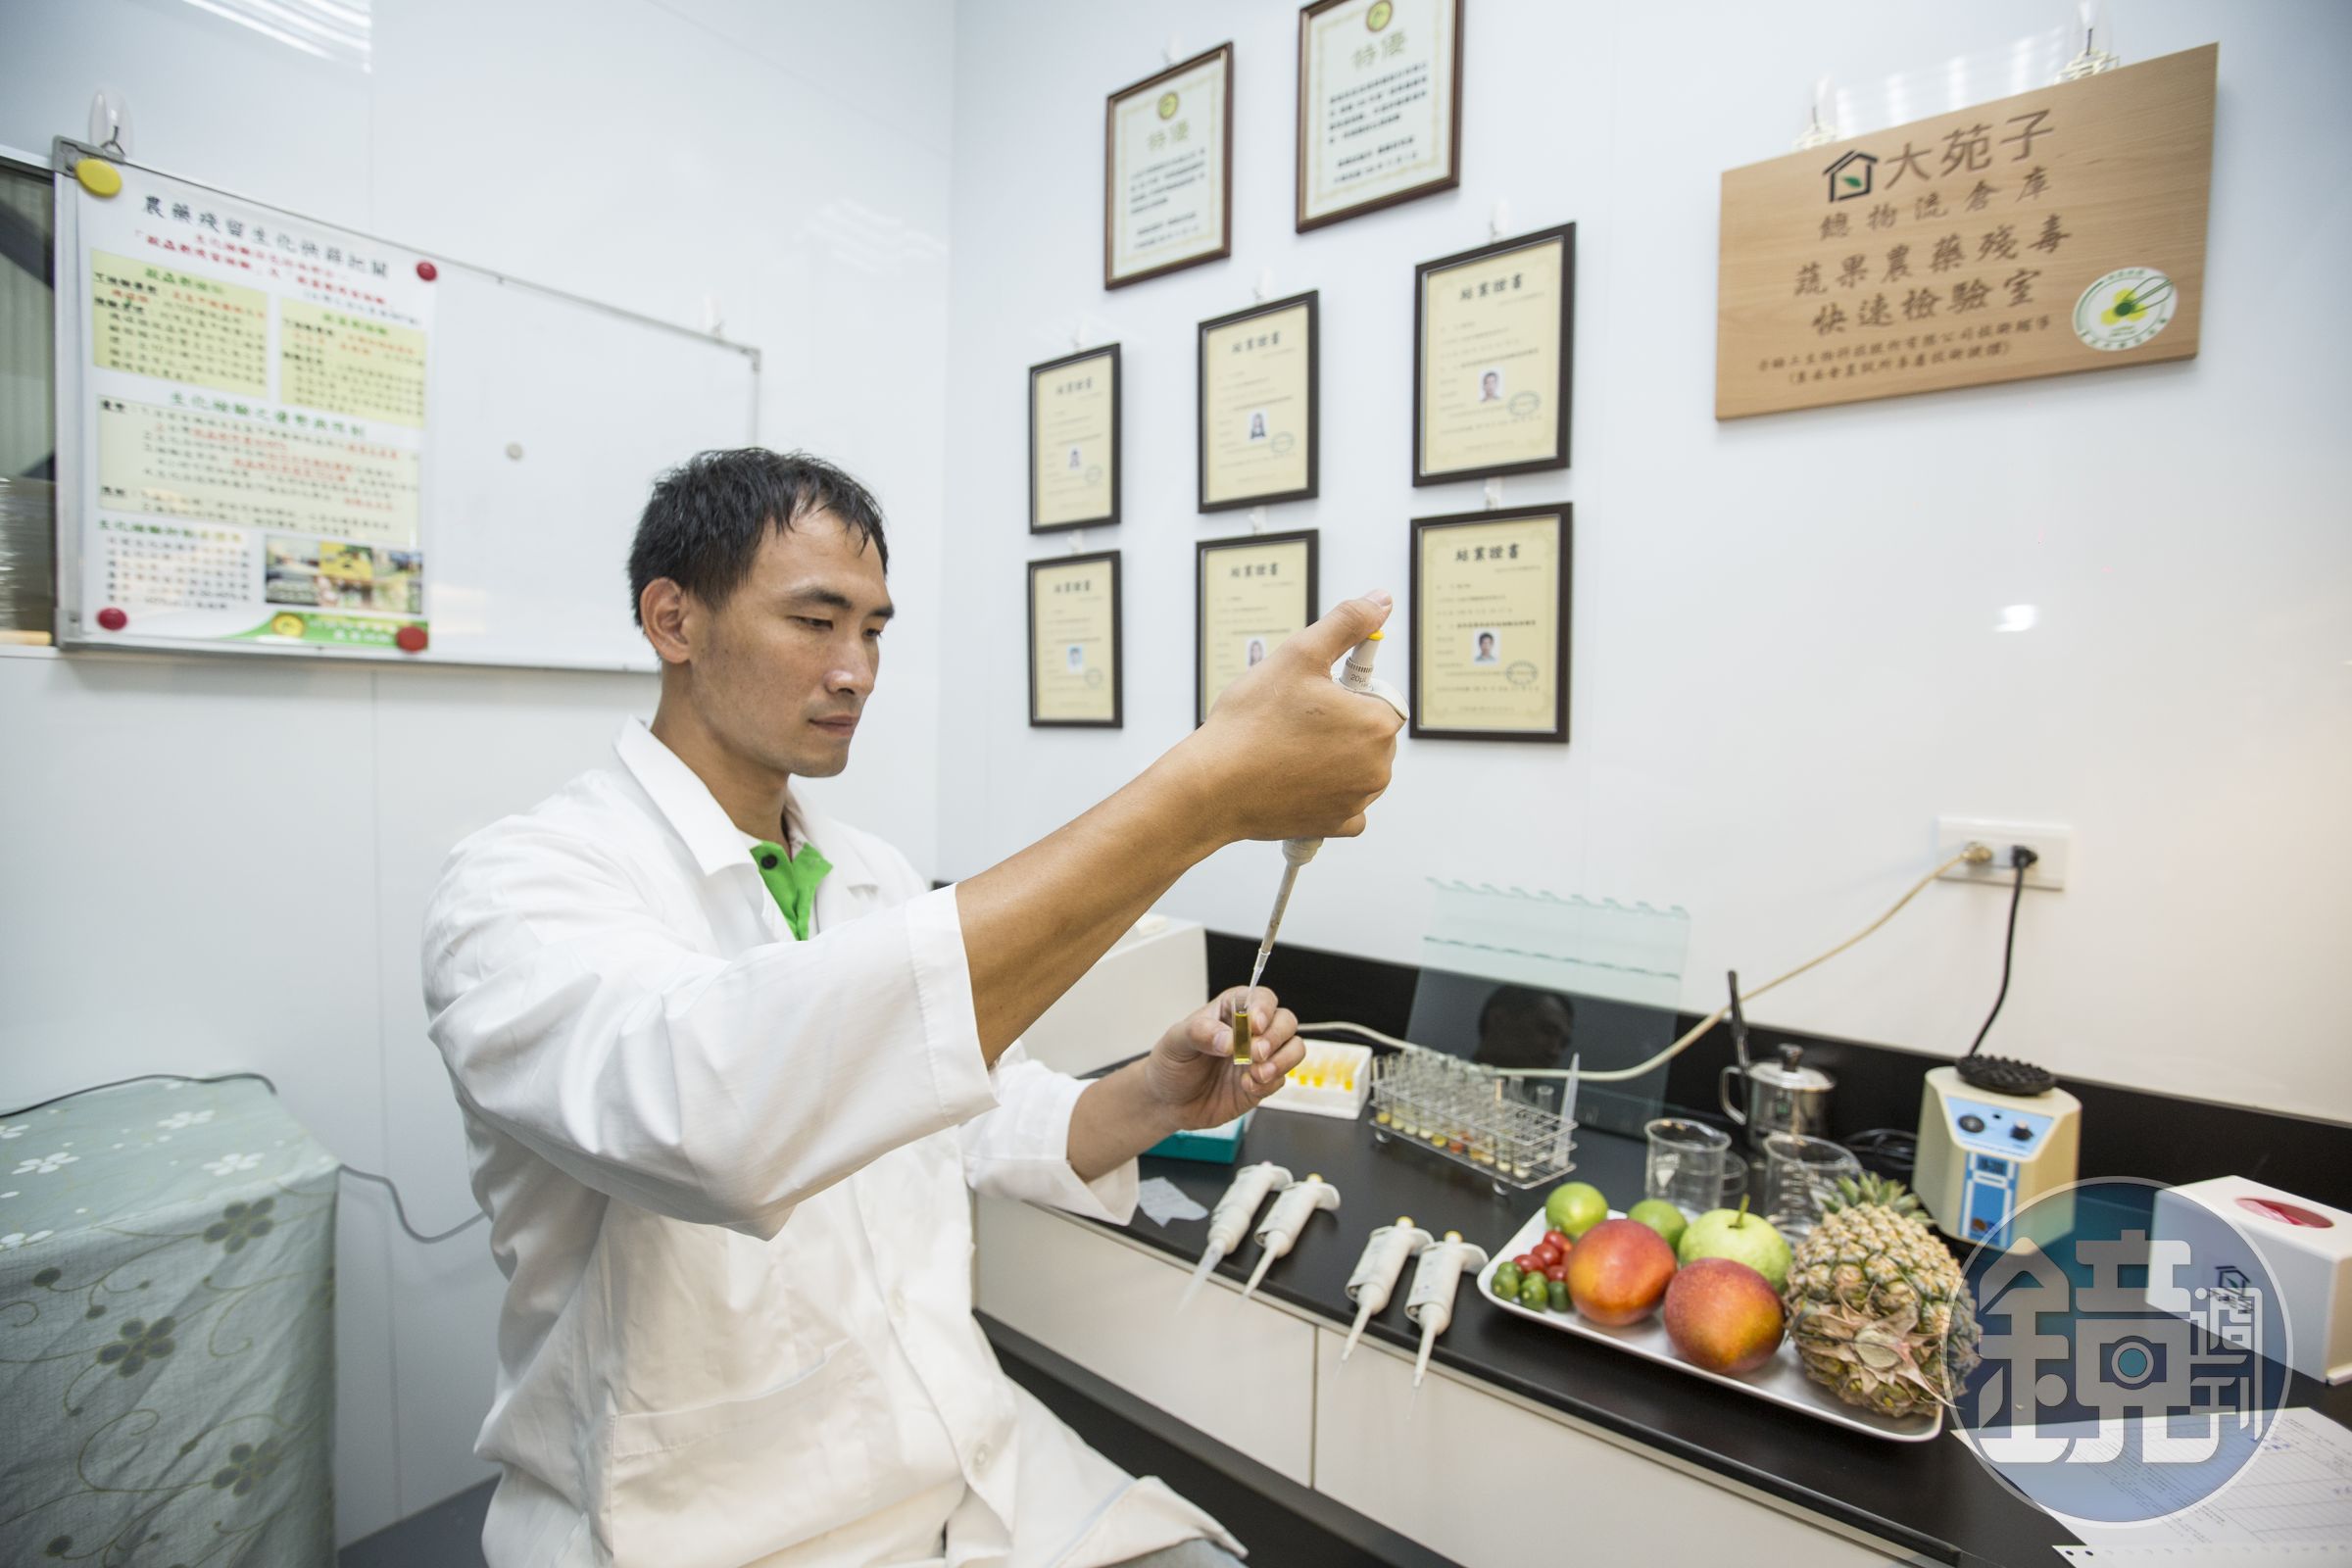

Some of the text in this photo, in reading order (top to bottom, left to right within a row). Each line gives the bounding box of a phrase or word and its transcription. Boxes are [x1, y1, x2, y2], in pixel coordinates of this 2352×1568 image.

[1884, 108, 2055, 190] 大苑子
[1819, 166, 2052, 242] 總物流倉庫
[1793, 214, 2074, 297] 蔬果農藥殘毒
[1811, 267, 2042, 337] 快速檢驗室
[1455, 543, 1521, 564] 結業證書
